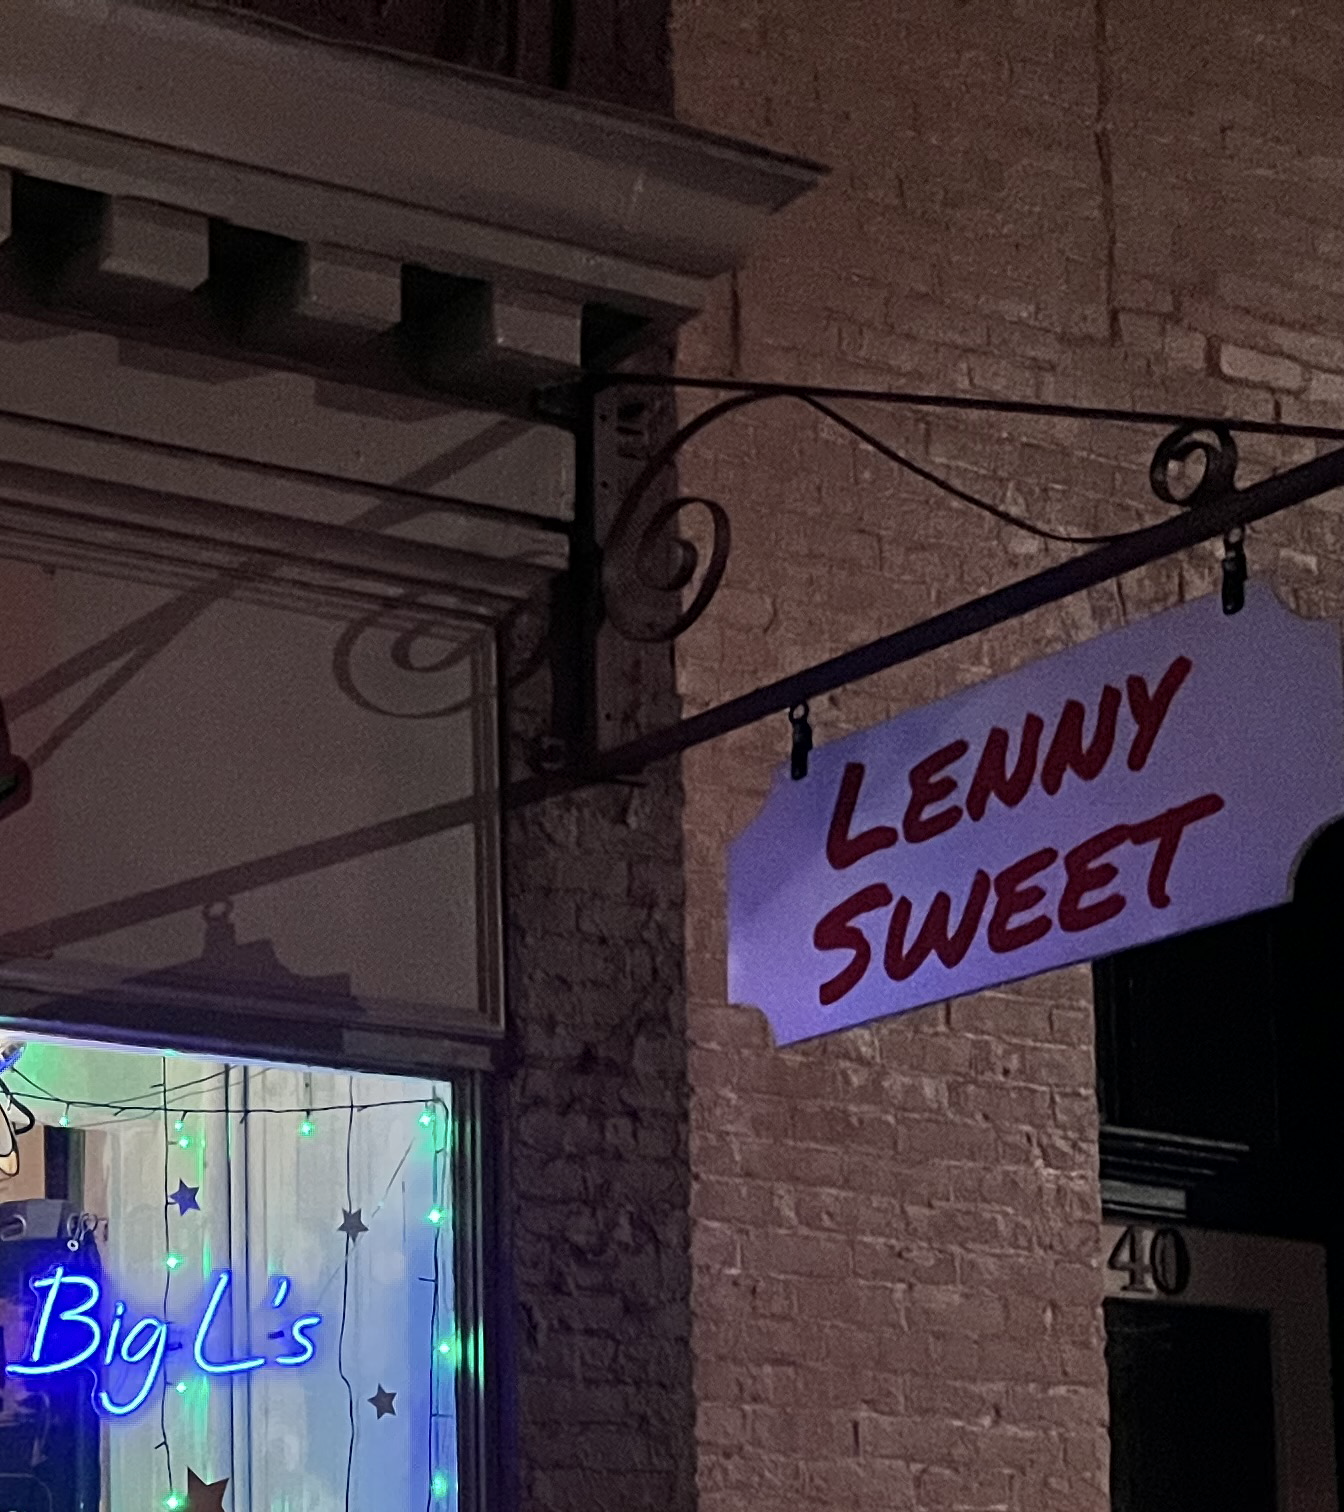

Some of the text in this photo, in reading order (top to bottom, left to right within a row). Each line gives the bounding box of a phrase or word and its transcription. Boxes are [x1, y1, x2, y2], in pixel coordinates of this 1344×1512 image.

[825, 656, 1193, 869] LENNY
[813, 793, 1225, 1005] SWEET
[5, 1264, 321, 1416] Big L's
[1107, 1224, 1191, 1296] 40
